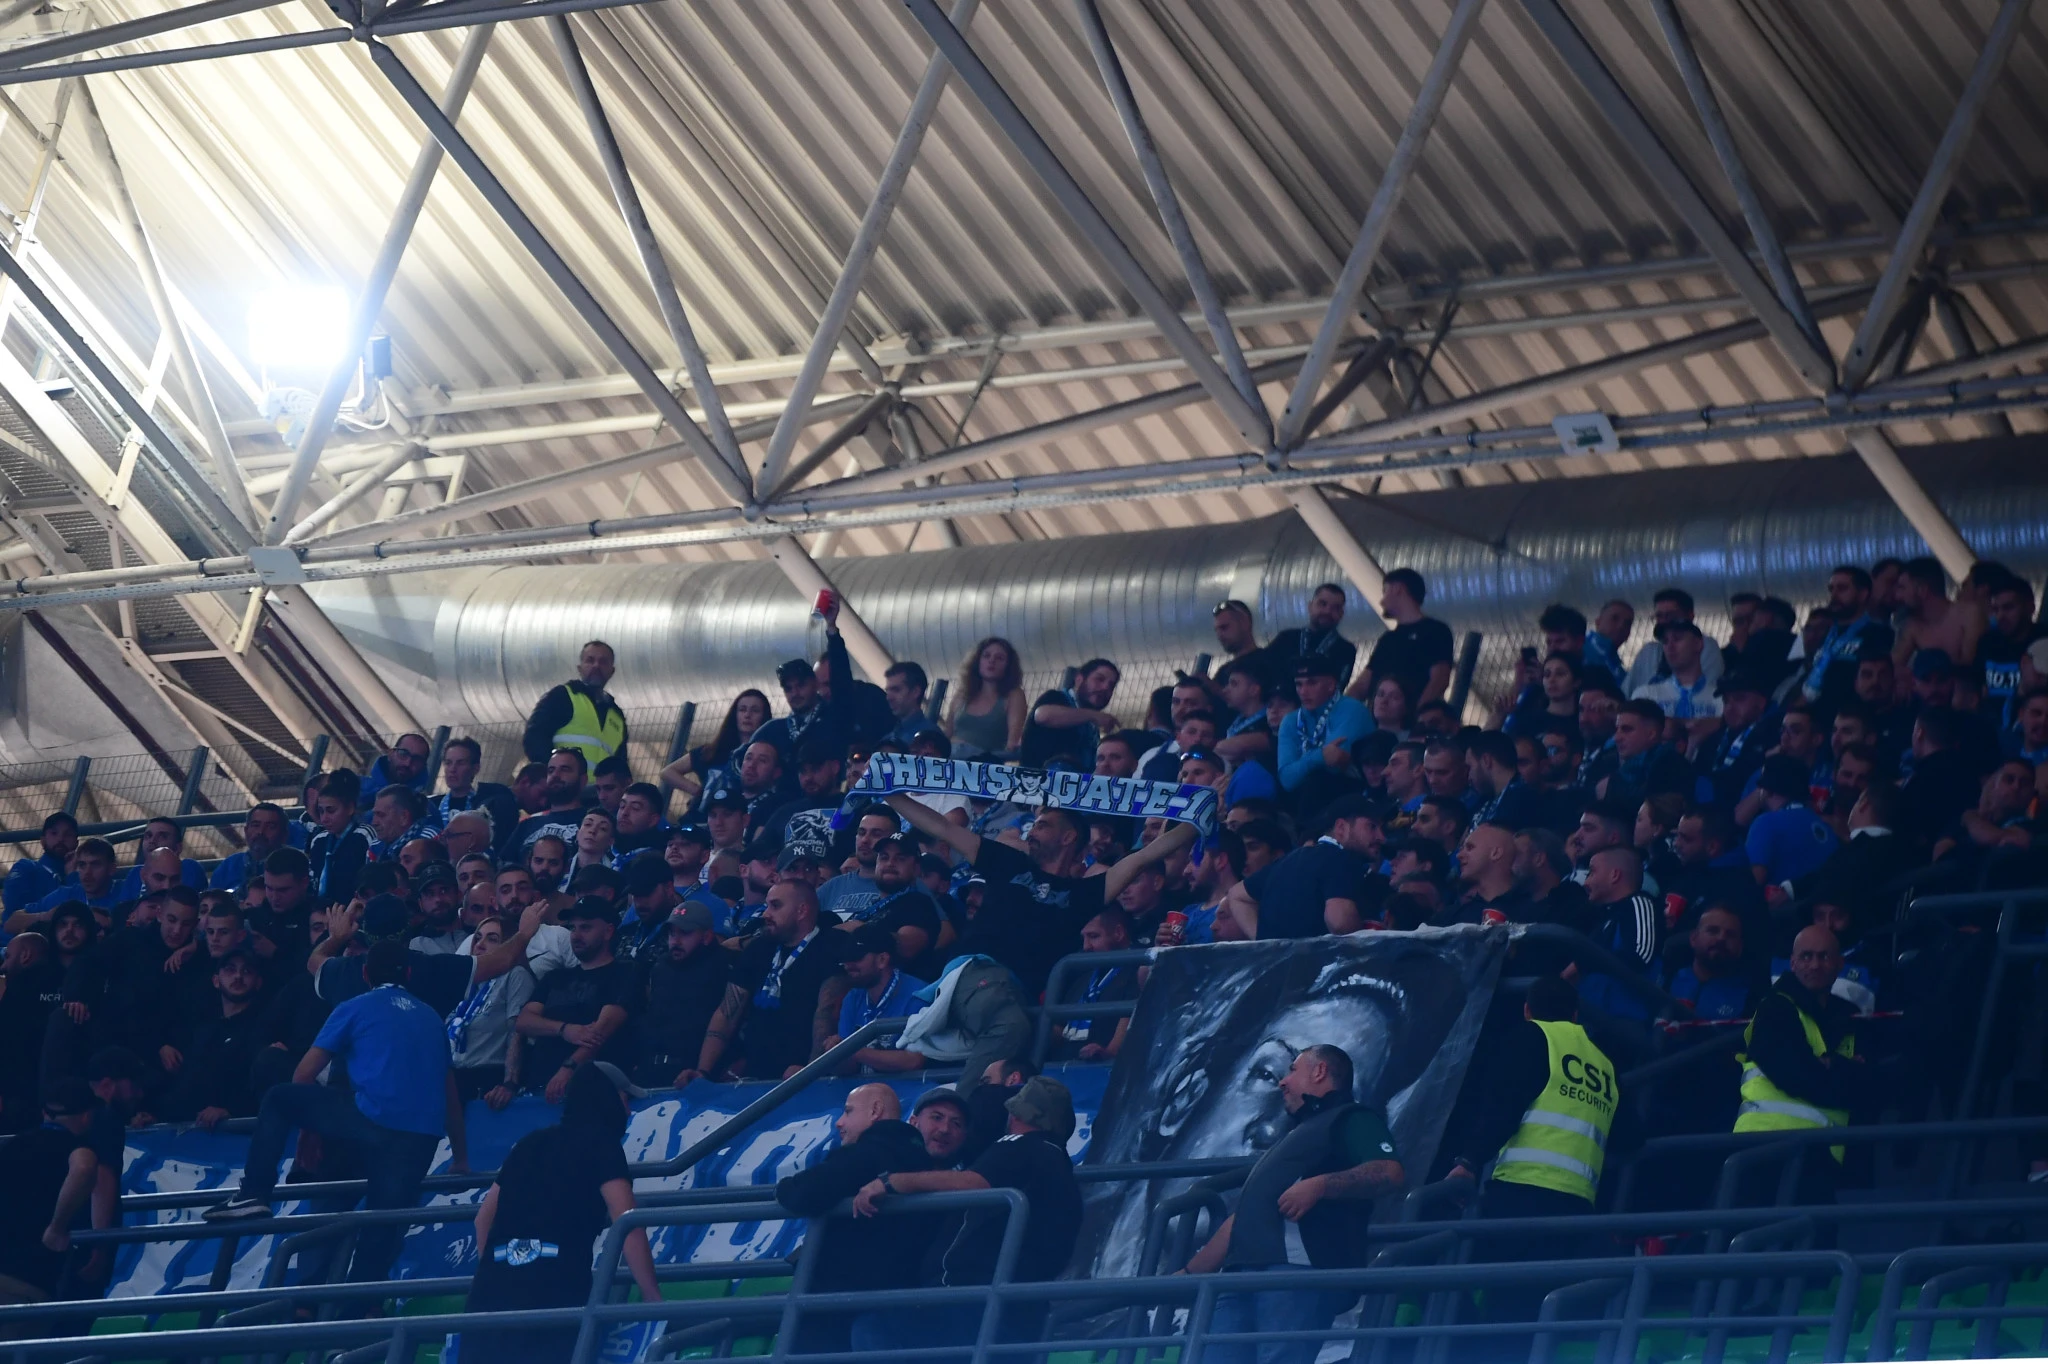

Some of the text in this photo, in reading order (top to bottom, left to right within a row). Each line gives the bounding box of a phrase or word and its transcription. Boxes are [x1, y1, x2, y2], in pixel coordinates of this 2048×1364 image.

[853, 753, 1014, 797] THENS
[1052, 771, 1179, 817] GATE
[1559, 1084, 1612, 1116] SECURITY
[1561, 1054, 1613, 1103] CSI
